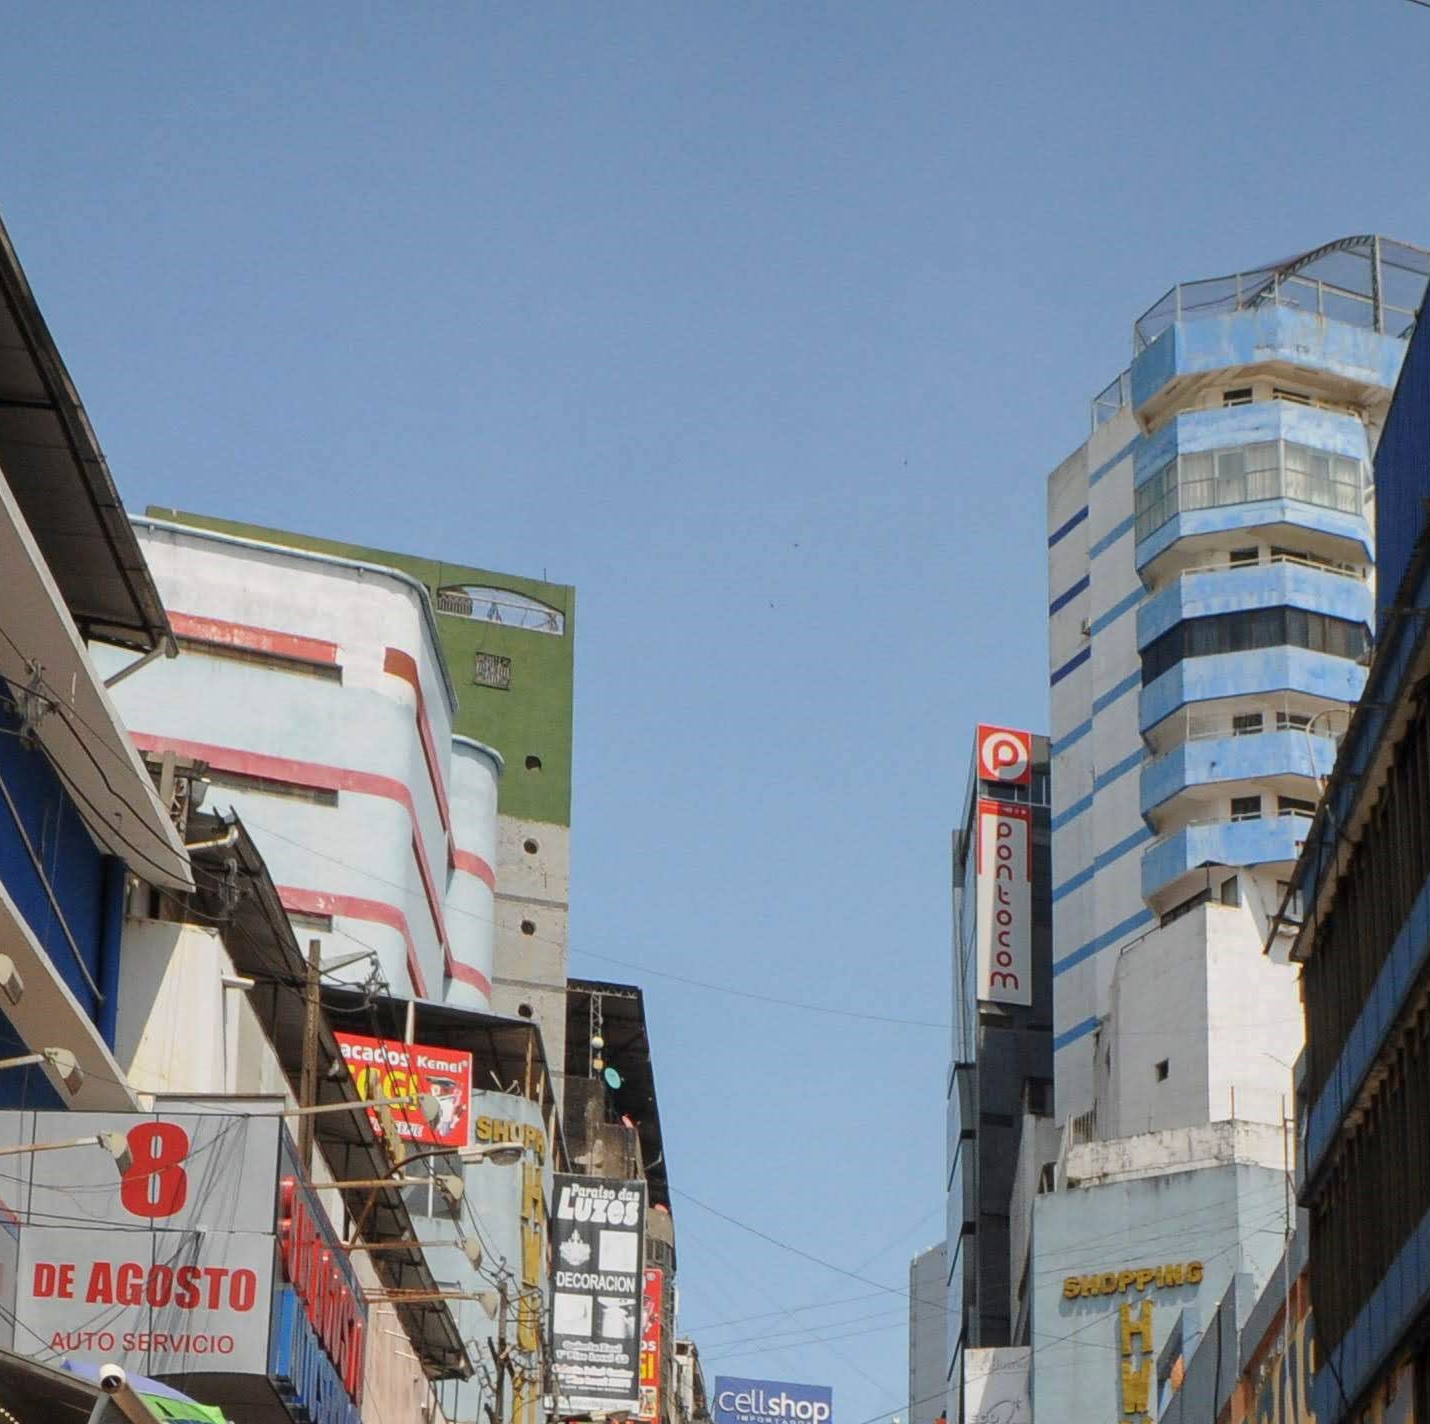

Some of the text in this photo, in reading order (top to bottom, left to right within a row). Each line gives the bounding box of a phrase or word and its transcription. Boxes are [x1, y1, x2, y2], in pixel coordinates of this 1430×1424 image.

[120, 1121, 190, 1219] 8
[32, 1262, 258, 1312] DE AGOSTO
[556, 1270, 636, 1293] DECORACION
[1064, 1260, 1203, 1298] SHOPPING
[50, 1331, 235, 1355] AUTO SERVICIO
